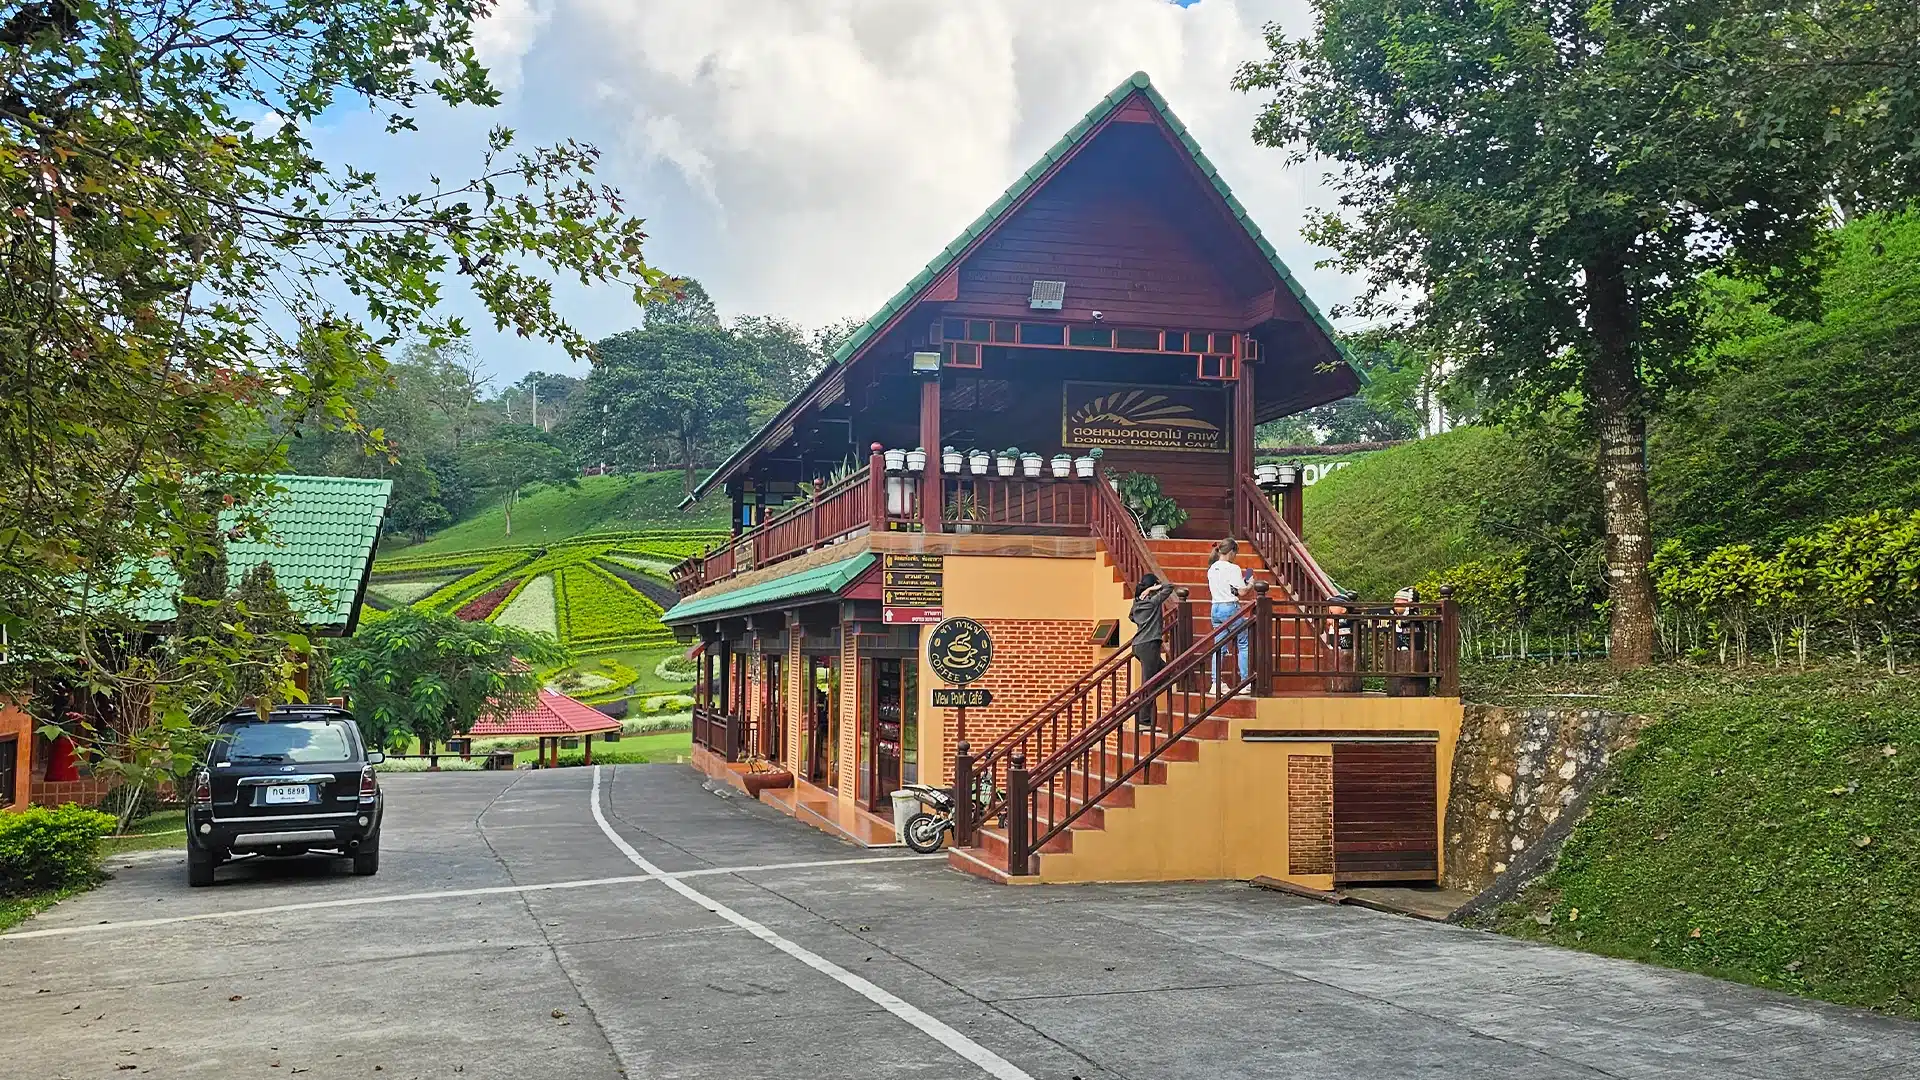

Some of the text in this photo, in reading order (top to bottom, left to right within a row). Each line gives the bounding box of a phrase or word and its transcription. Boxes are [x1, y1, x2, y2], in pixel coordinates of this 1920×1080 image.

[1073, 427, 1182, 440] ดอยหมอกดอกไม้
[1074, 437, 1127, 445] DOIMOK
[1130, 439, 1181, 447] DOKMAI
[931, 653, 960, 682] COFFEE
[973, 654, 989, 674] TEA
[934, 690, 983, 705] View Point Café
